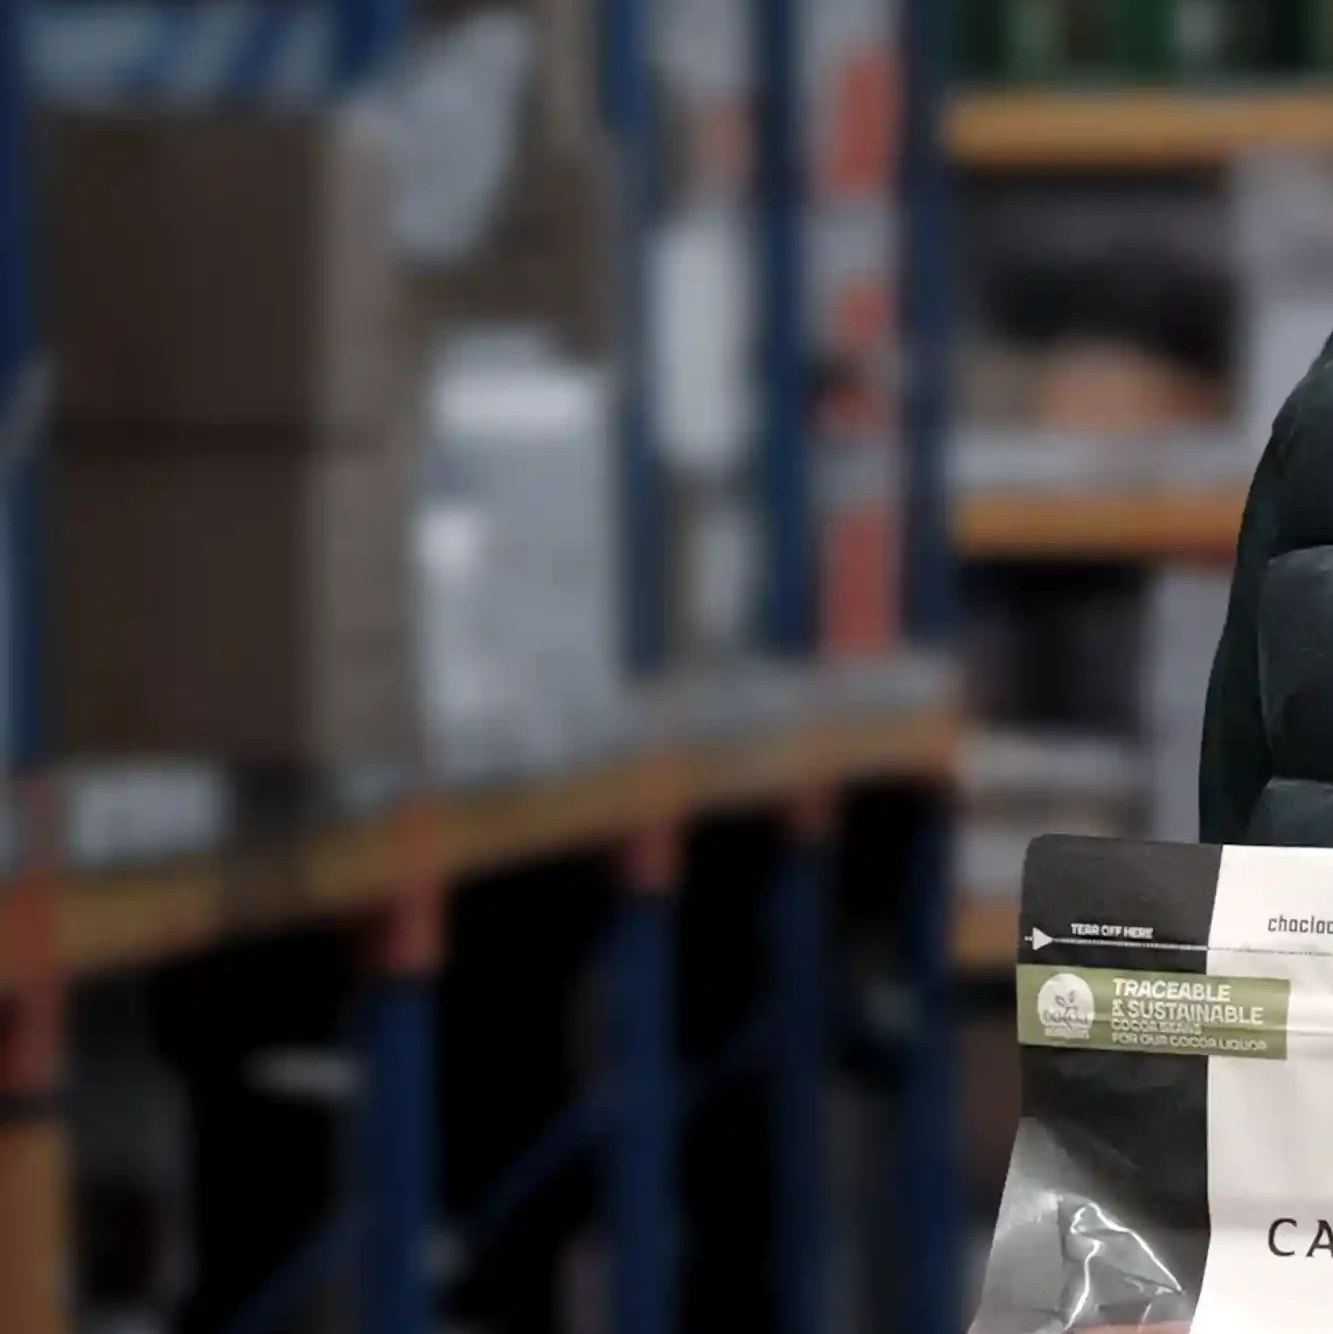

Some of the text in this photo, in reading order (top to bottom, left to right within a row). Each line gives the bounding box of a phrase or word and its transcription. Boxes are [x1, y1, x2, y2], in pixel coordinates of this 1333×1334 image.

[1101, 924, 1122, 937] OFF
[1112, 978, 1232, 1002] TRACEABLE
[1127, 1000, 1265, 1025] SUSTAINABLE
